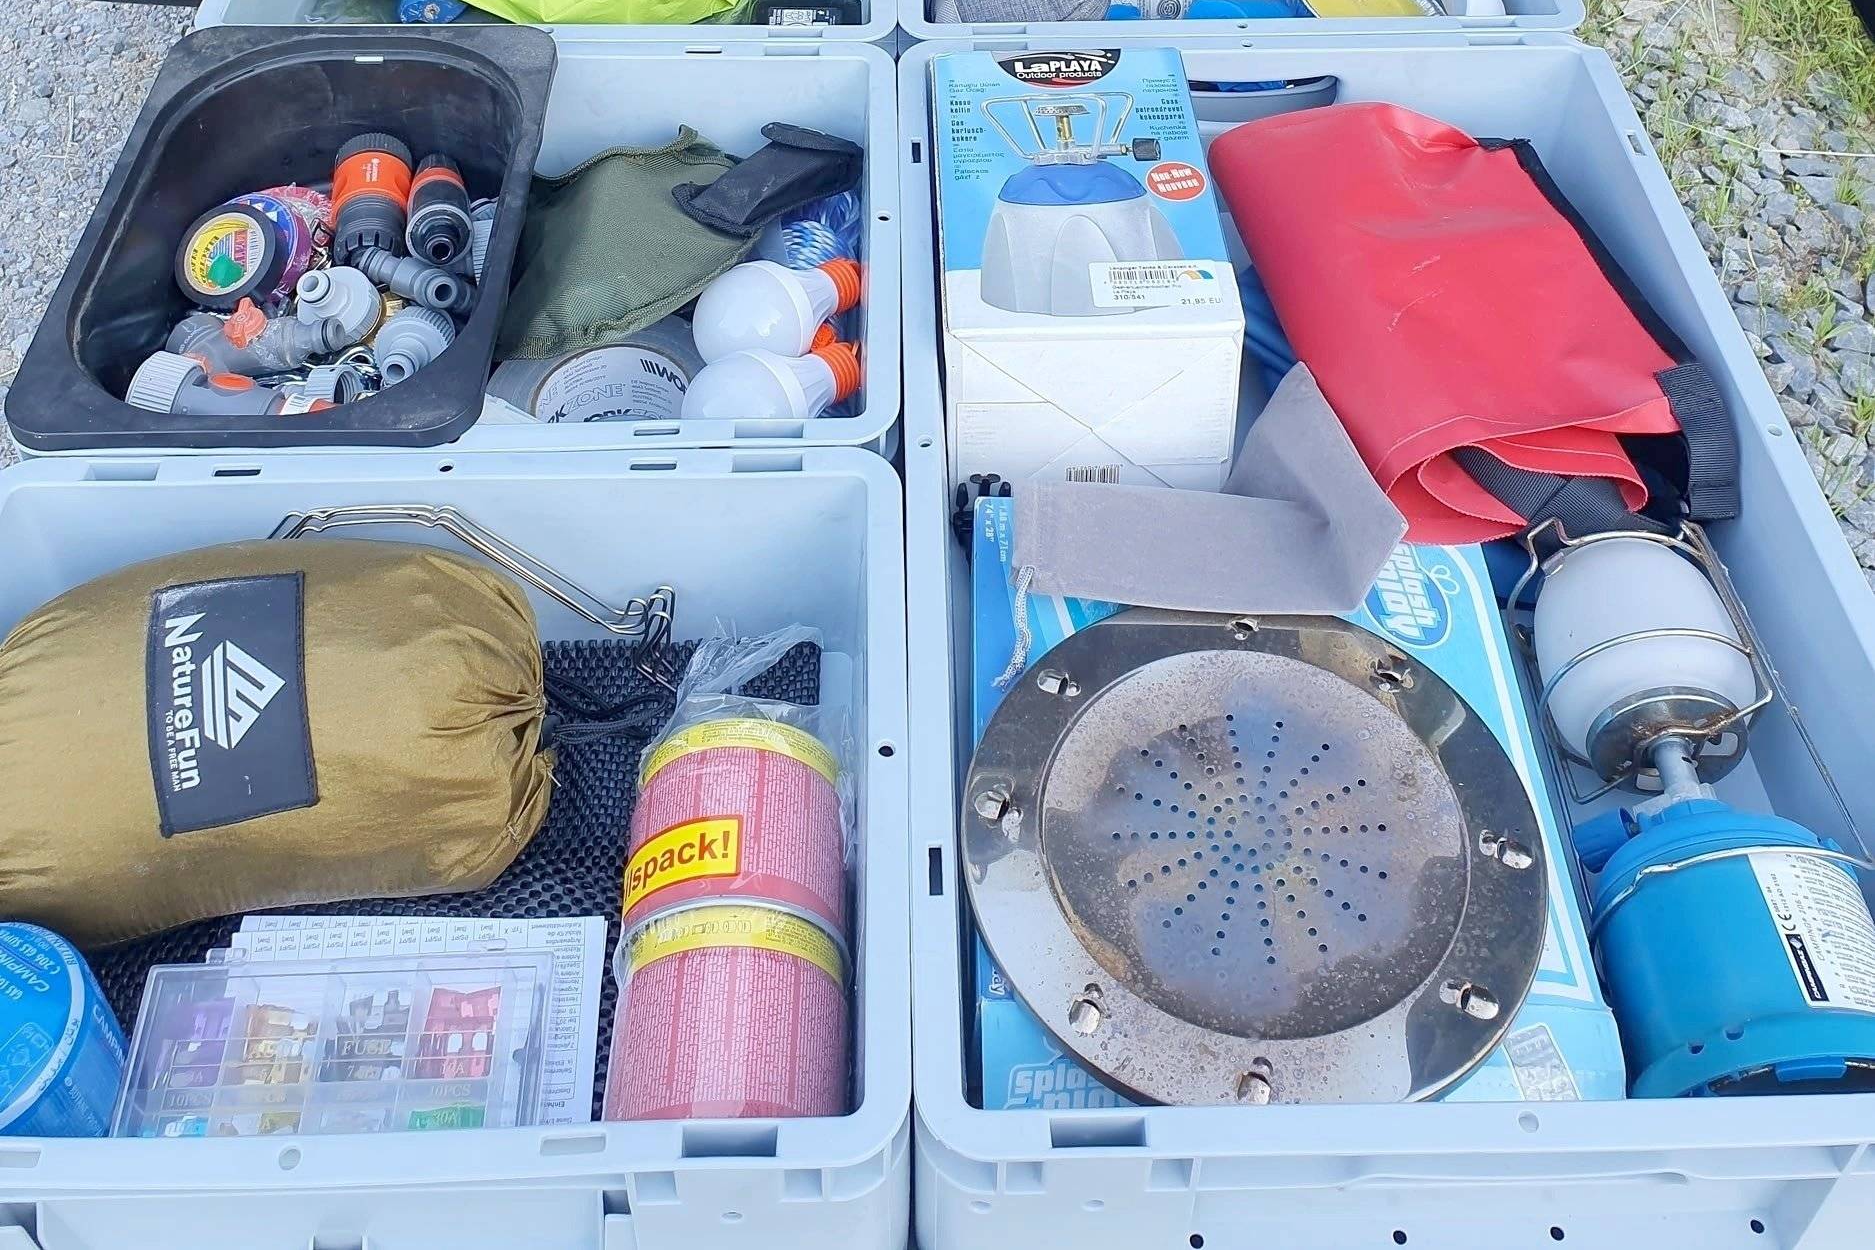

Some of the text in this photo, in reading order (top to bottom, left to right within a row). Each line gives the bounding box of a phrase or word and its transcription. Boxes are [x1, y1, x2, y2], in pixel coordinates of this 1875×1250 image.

[1016, 71, 1103, 79] Outdoor products
[164, 612, 207, 790] NatureFun
[168, 748, 178, 770] FREE
[170, 771, 182, 793] MAN
